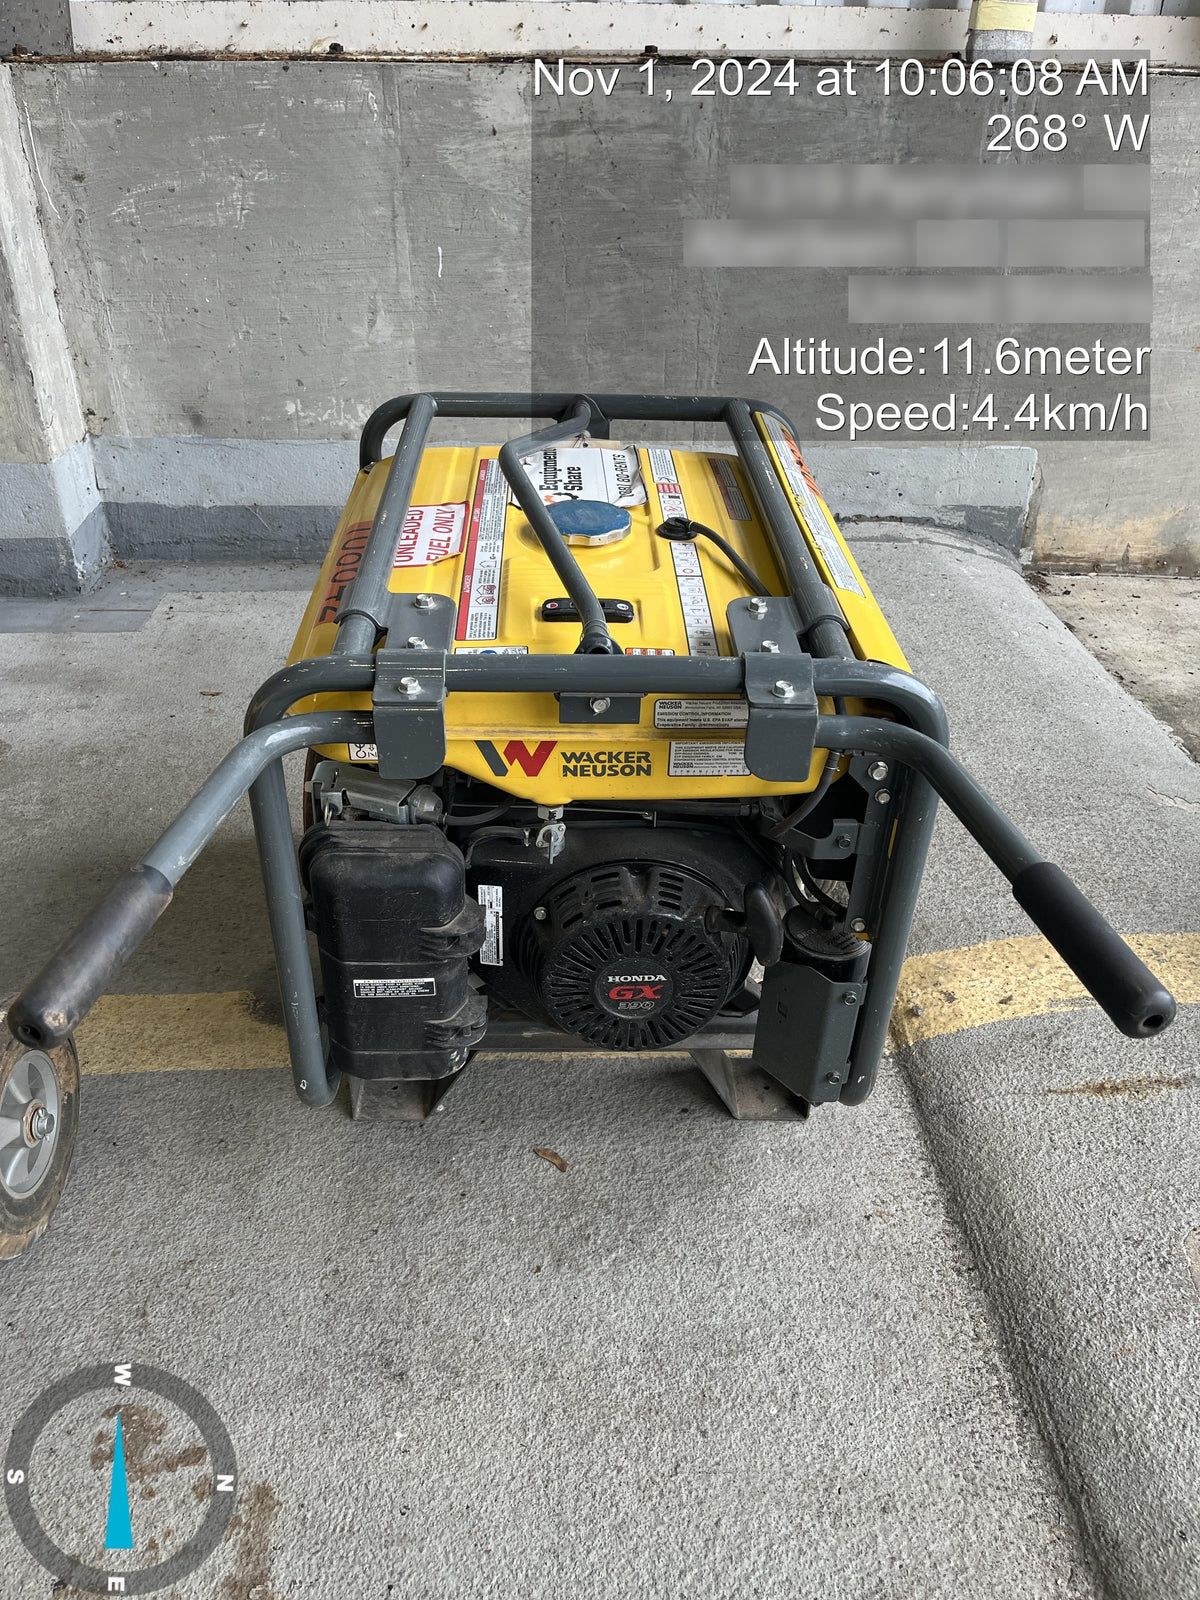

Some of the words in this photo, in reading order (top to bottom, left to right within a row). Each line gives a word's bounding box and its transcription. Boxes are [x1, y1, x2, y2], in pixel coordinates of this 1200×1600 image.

[563, 466, 583, 491] Share
[612, 454, 630, 483] 80-RENTS
[432, 508, 455, 534] ONLY
[395, 509, 424, 562] UNLEADED
[426, 537, 451, 561] FUEL
[560, 751, 652, 764] WACKER
[562, 764, 652, 777] NEUSON
[607, 974, 667, 983] HONDA
[608, 984, 665, 1000] GX
